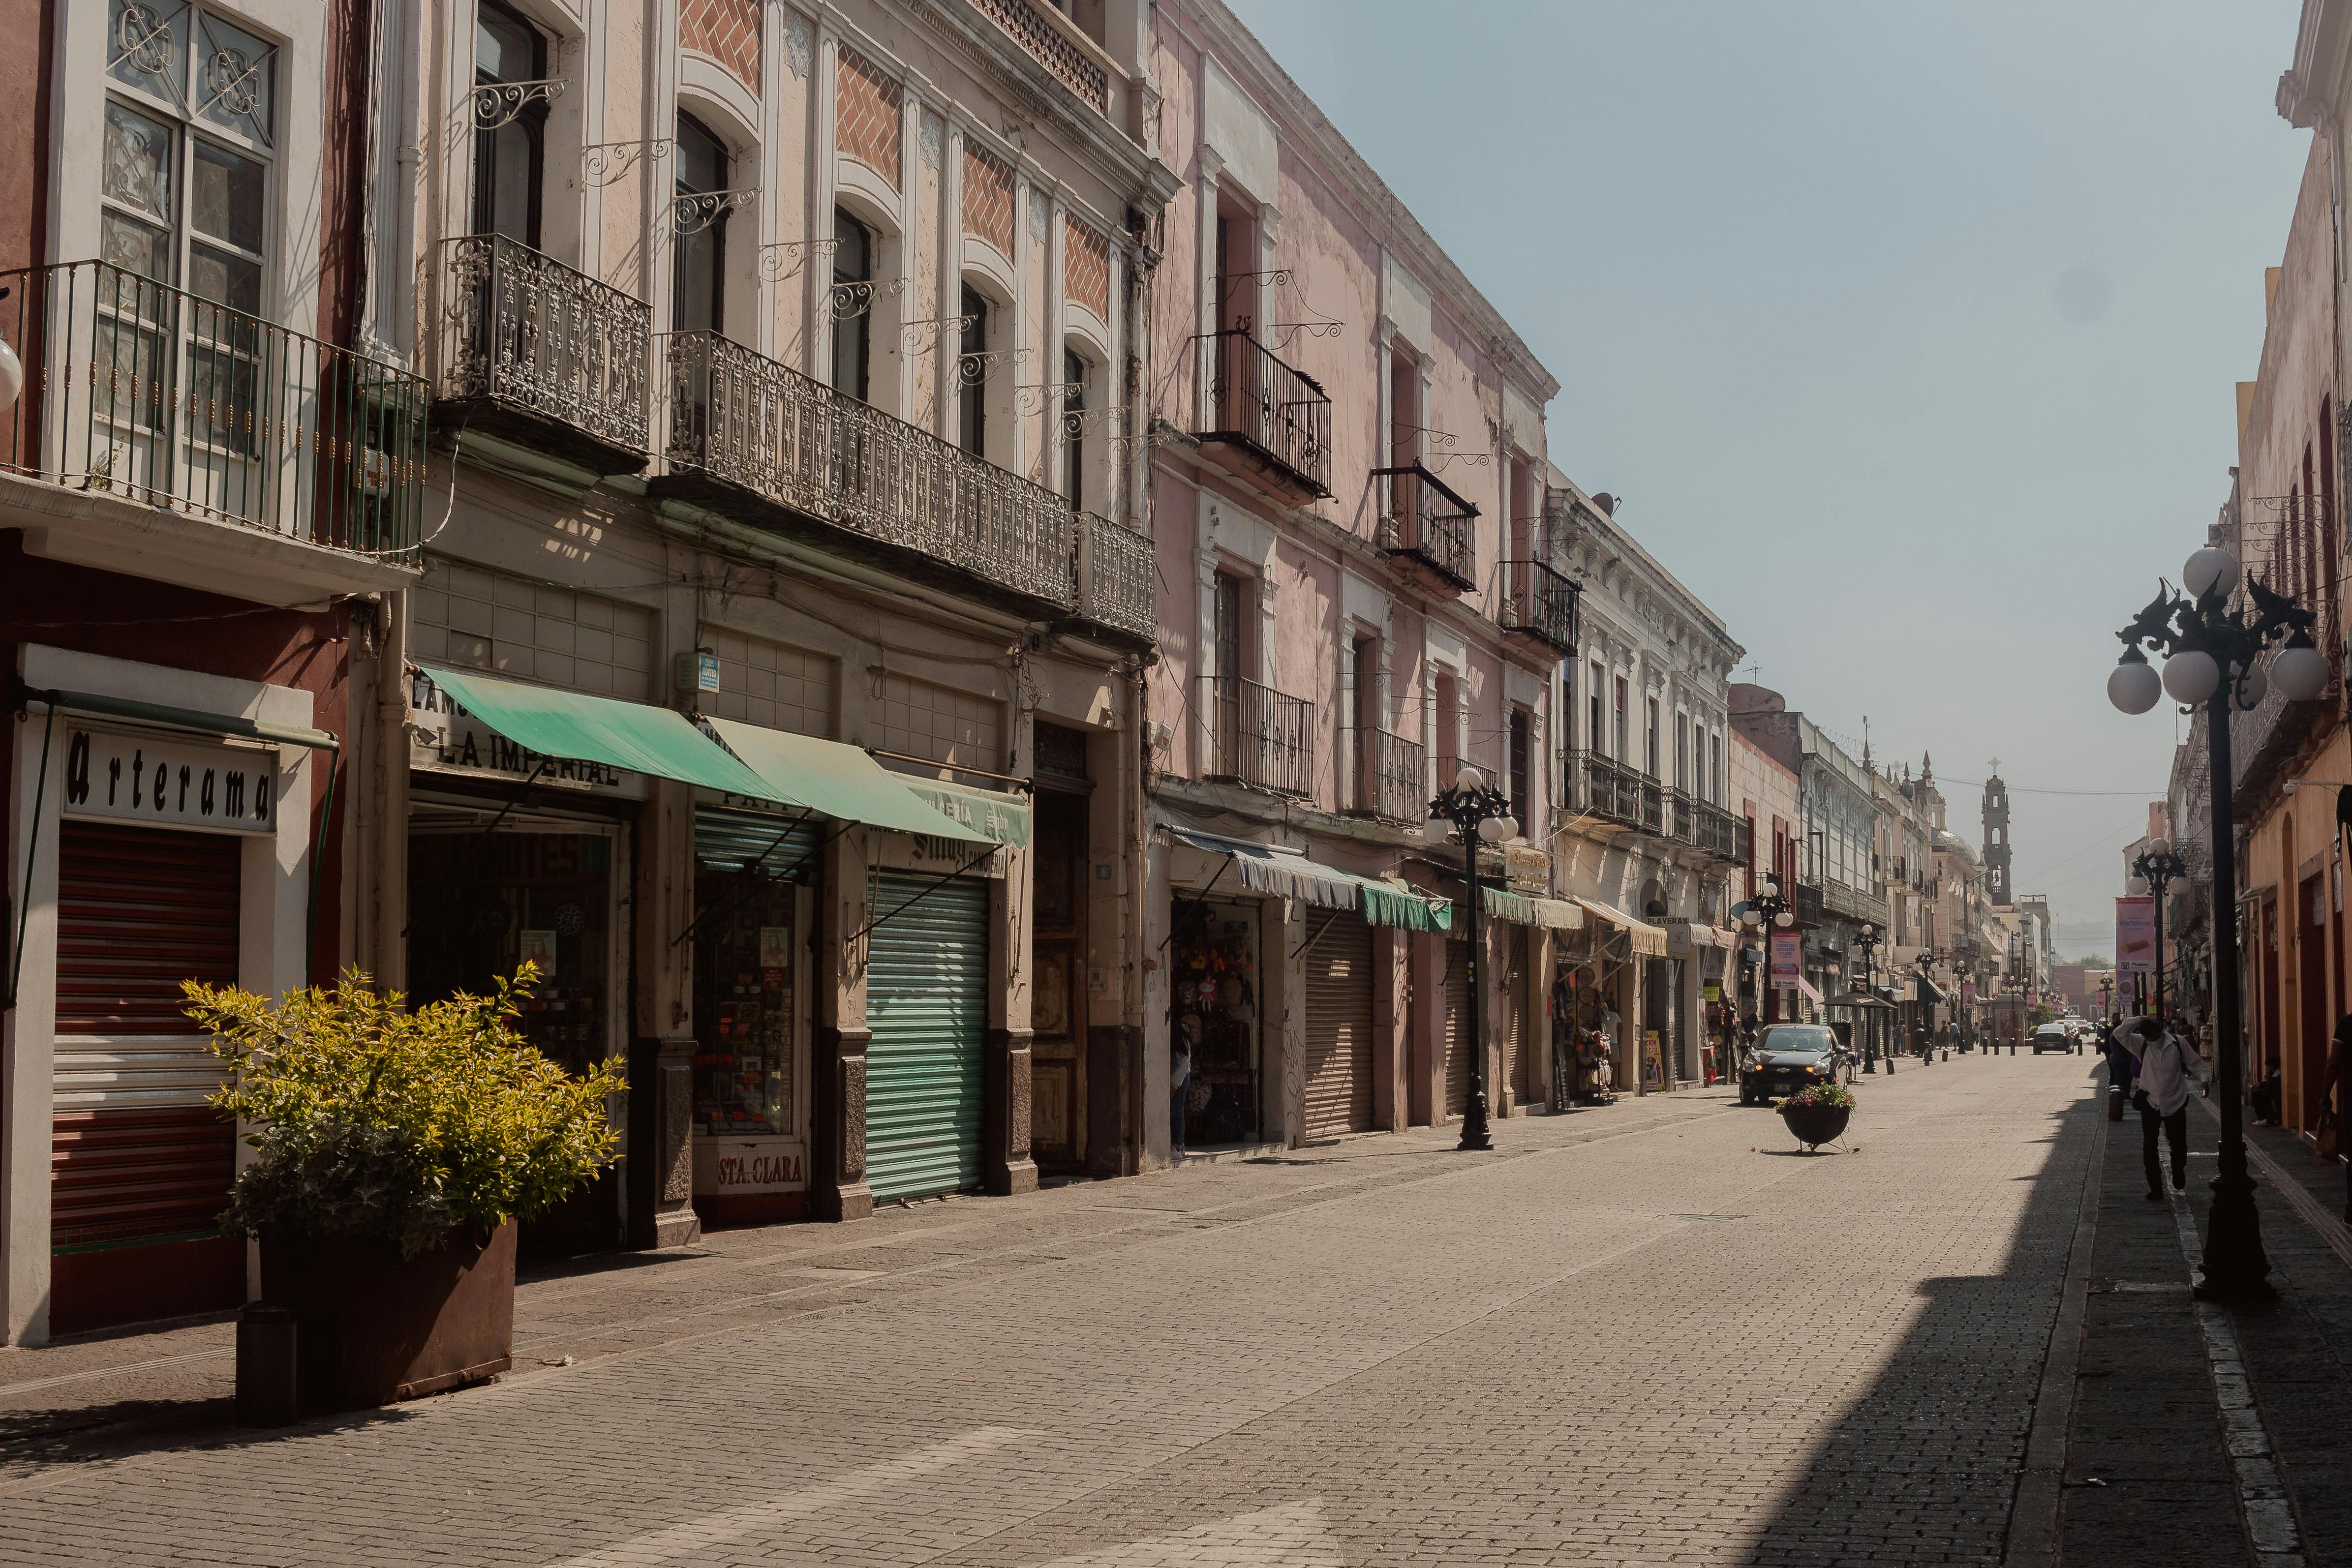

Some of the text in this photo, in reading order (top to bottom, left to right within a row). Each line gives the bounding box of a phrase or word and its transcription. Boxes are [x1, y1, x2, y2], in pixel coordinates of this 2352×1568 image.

[436, 726, 483, 768] LA
[719, 1155, 802, 1184] STA. CLARA
